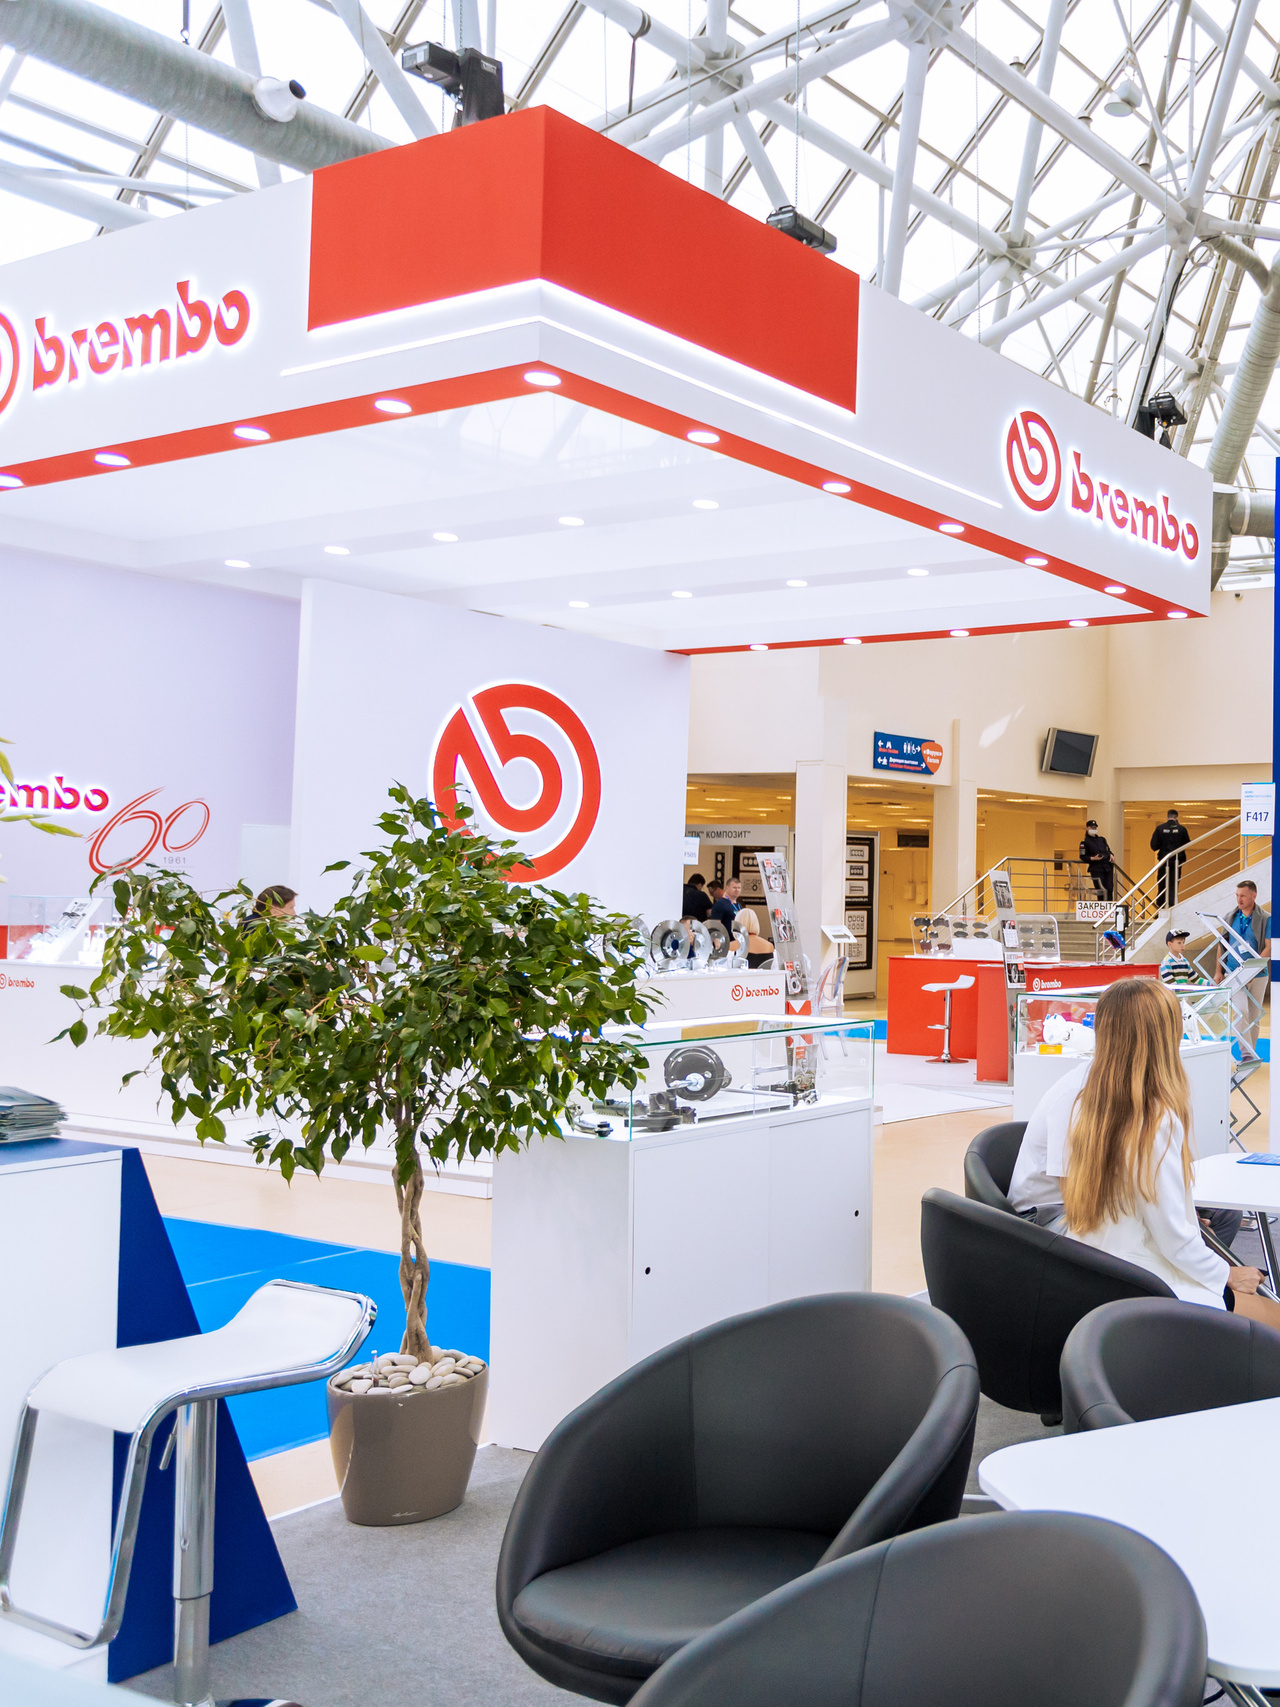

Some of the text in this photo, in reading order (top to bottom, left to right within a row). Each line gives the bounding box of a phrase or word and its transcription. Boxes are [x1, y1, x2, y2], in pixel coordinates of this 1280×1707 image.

[33, 280, 250, 392] brembo
[1071, 450, 1199, 560] brembo
[0, 776, 109, 811] mbo
[1246, 811, 1269, 822] F417
[163, 856, 186, 865] 1961
[8, 976, 35, 988] brembo
[1041, 979, 1062, 989] brembo
[745, 985, 780, 998] brembo
